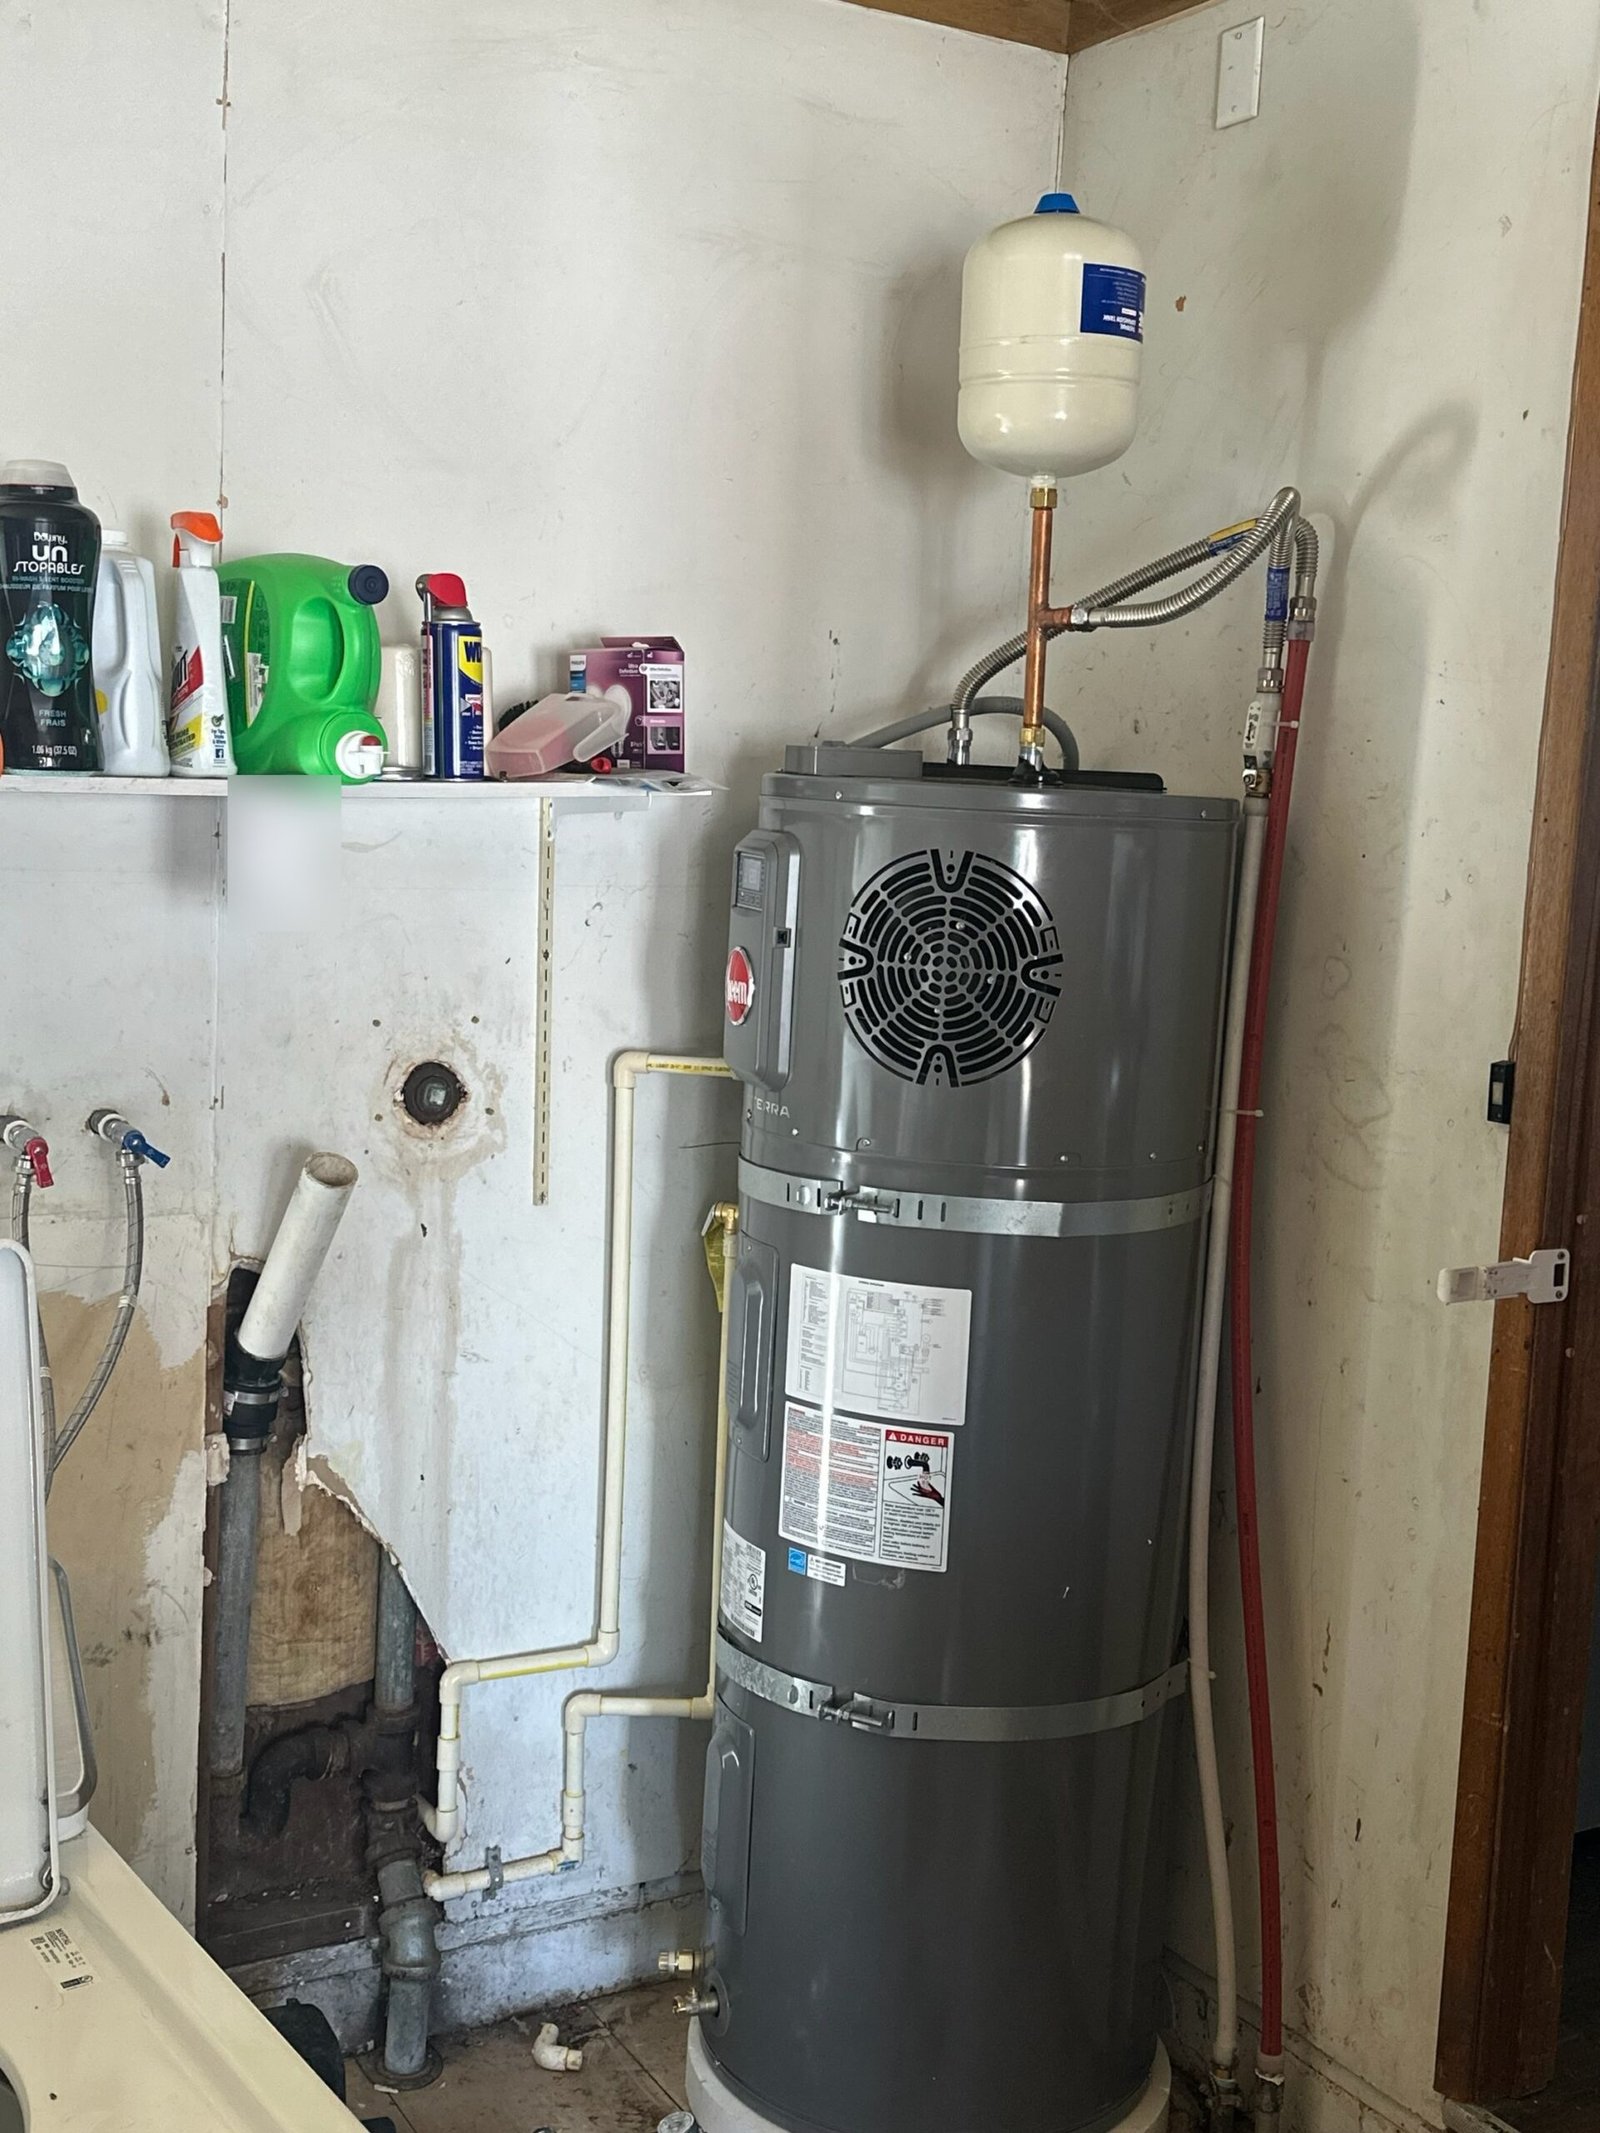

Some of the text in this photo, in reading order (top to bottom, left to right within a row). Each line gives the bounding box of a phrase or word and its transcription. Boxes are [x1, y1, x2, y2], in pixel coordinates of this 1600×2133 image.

[33, 532, 66, 545] Downy
[32, 545, 67, 562] un
[13, 560, 86, 575] STOPABLES
[38, 709, 67, 718] FRESH
[40, 718, 67, 728] FRAIS
[754, 1095, 791, 1119] ERRA
[900, 1433, 945, 1446] DANGER
